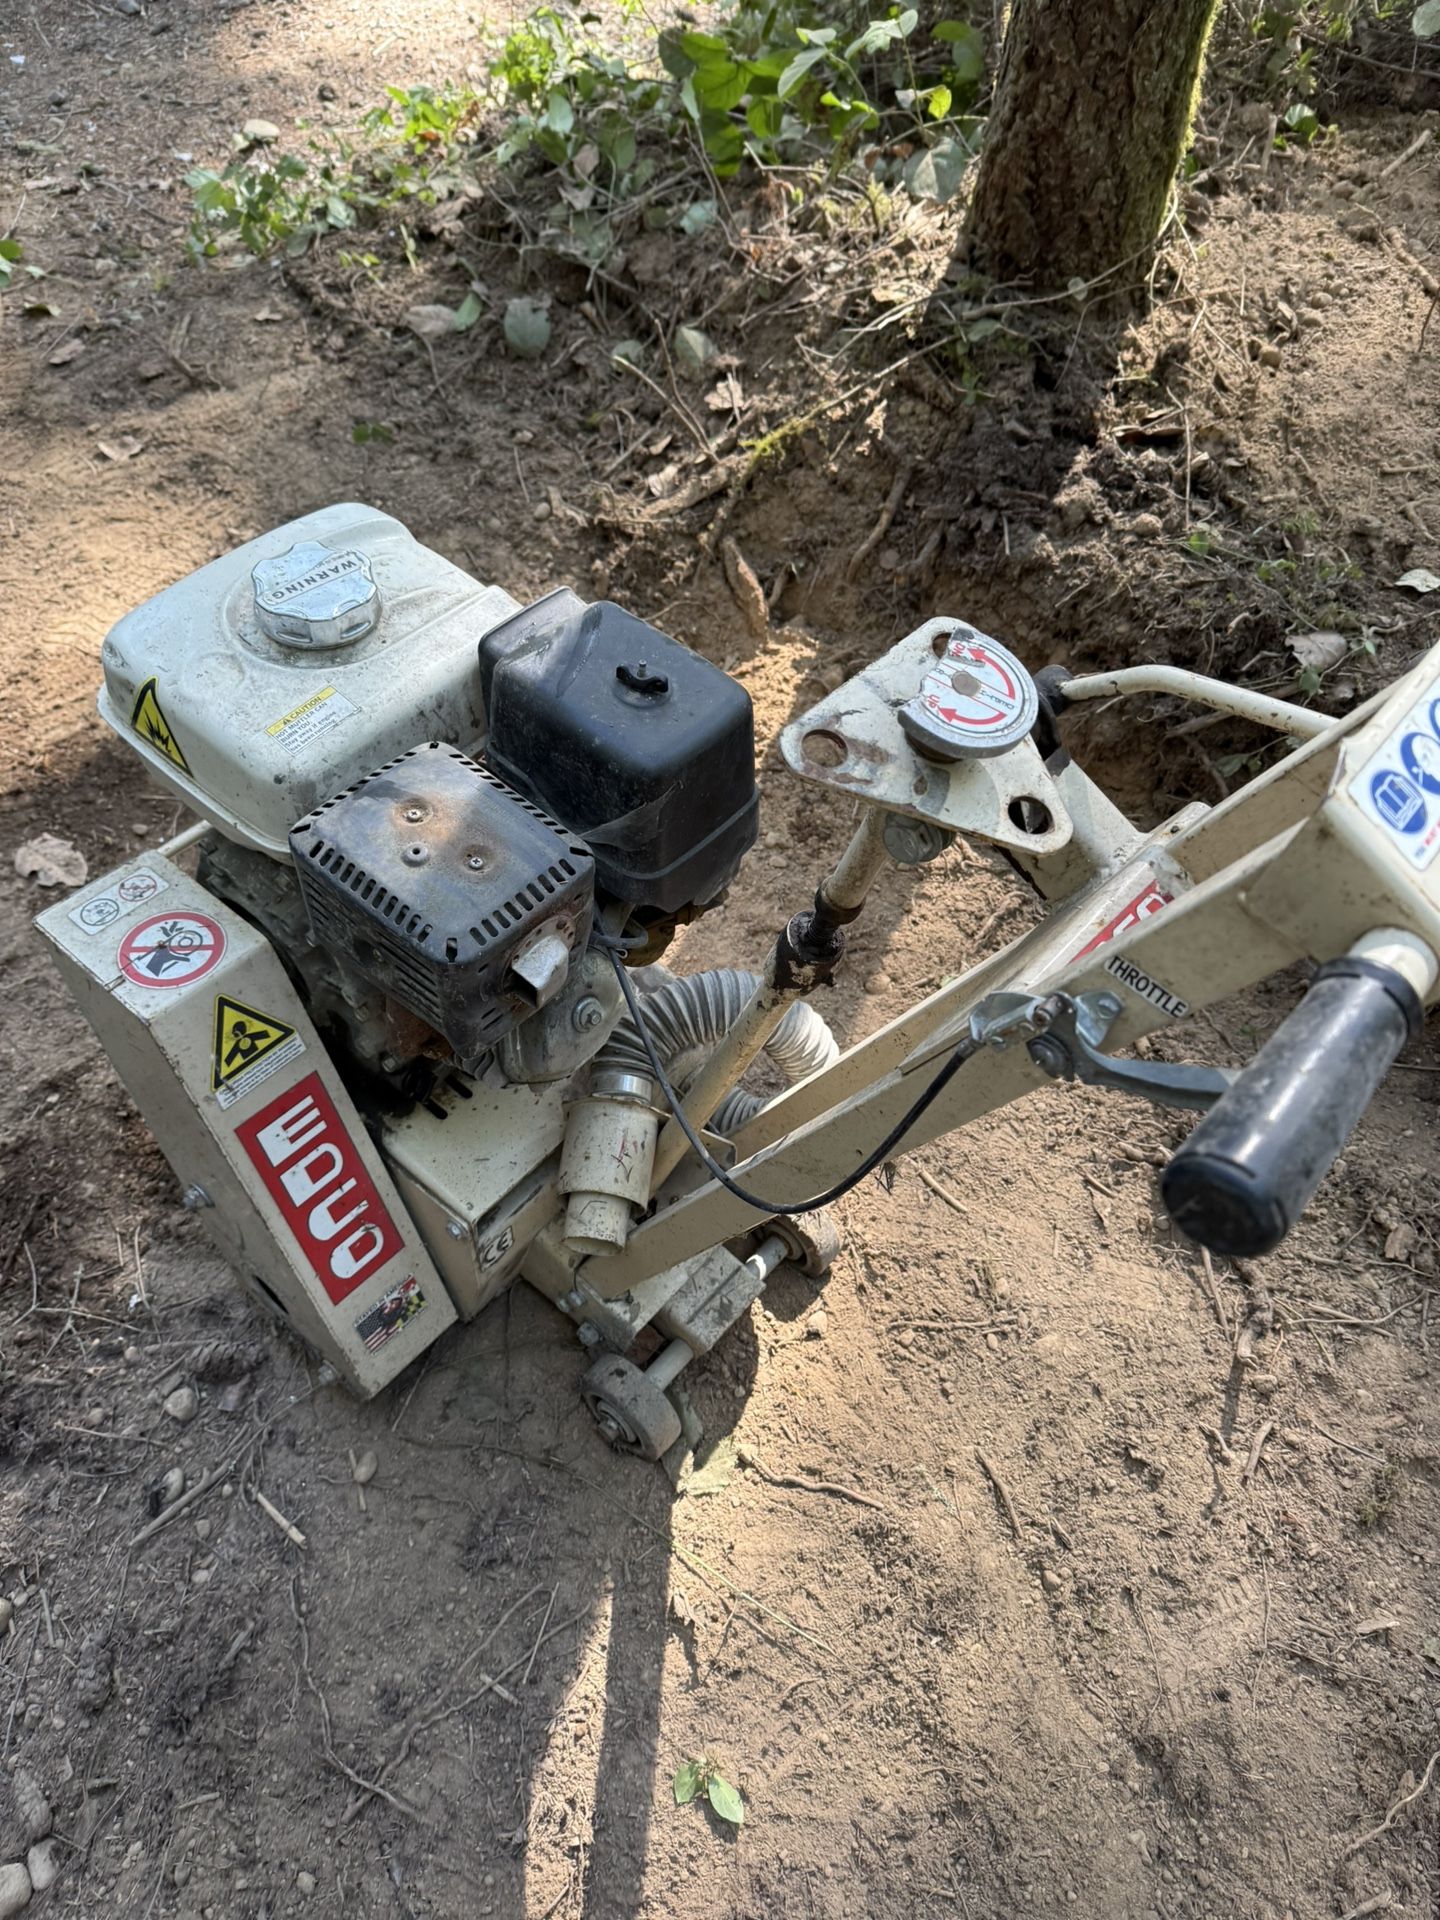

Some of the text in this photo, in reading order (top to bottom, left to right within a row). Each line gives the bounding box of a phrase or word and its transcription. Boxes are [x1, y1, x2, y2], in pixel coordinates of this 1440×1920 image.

[272, 560, 357, 599] WARNING
[275, 728, 288, 738] HOT
[314, 701, 327, 712] CAN
[290, 695, 322, 719] CAUTION
[928, 695, 940, 708] UP
[280, 728, 298, 742] BURN
[1107, 956, 1187, 1018] THROTTLE
[256, 1095, 384, 1279] EDCO
